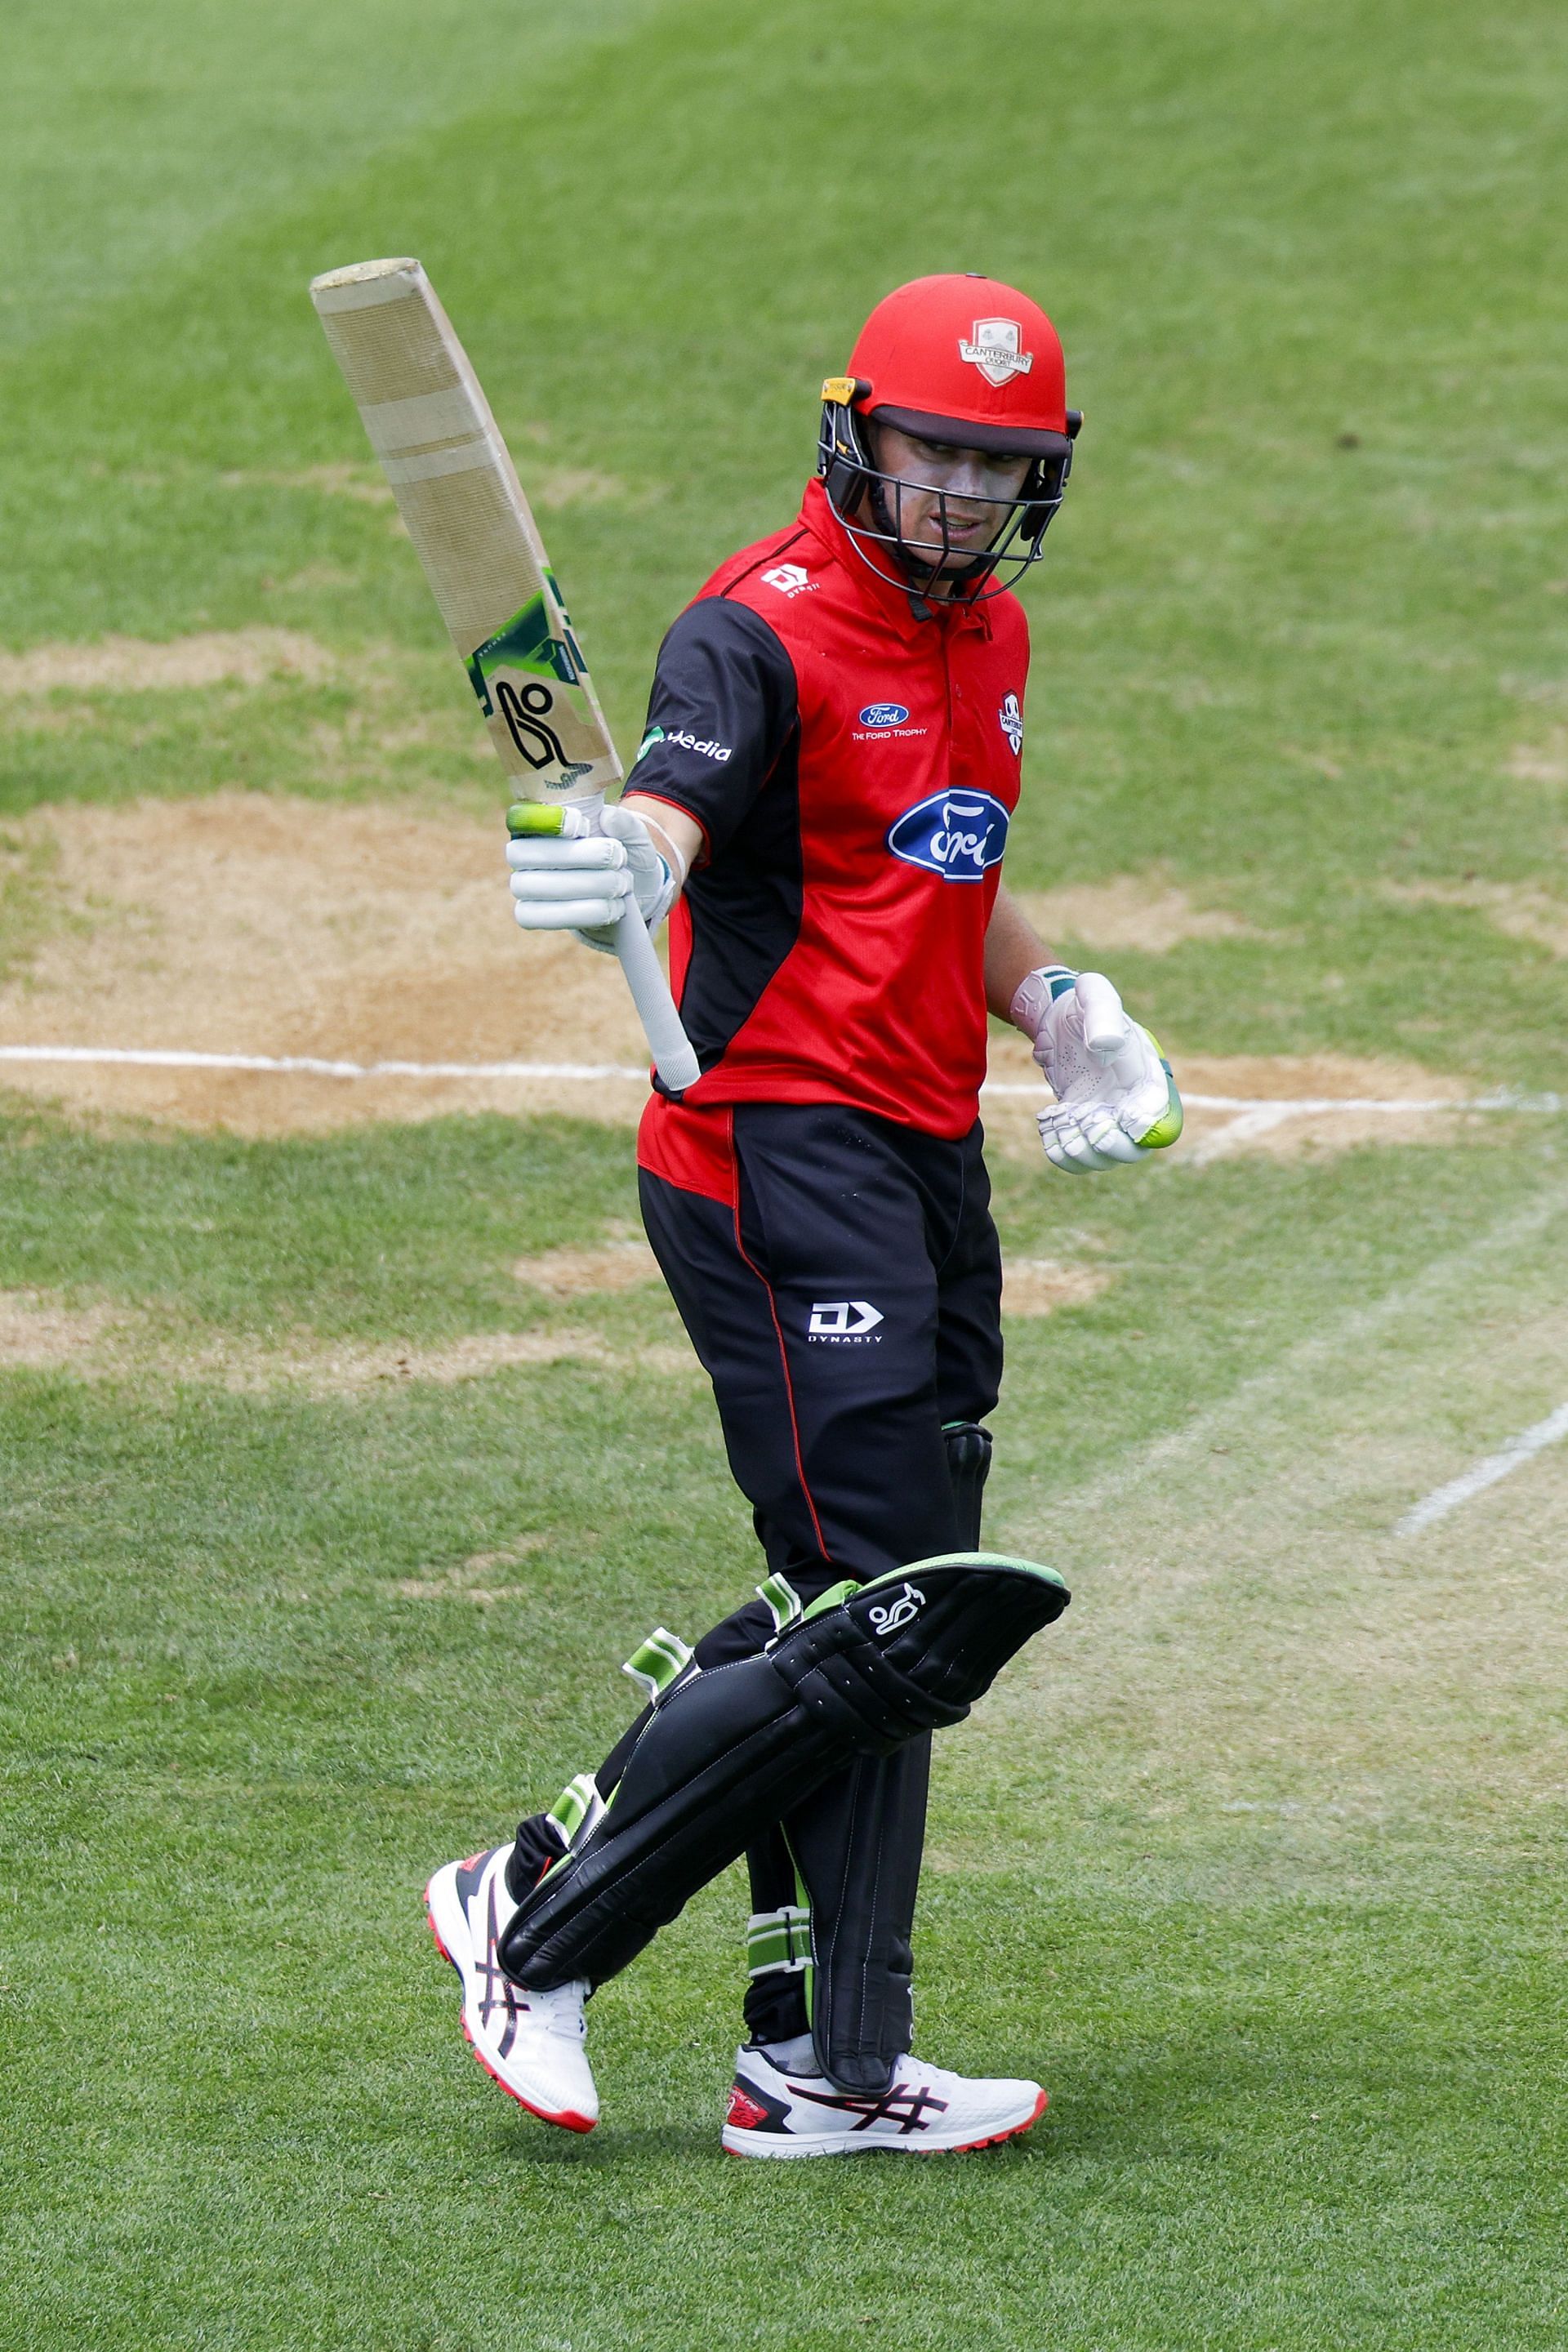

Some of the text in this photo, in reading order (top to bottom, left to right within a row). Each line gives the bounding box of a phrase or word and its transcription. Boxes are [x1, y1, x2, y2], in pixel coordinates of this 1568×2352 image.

[965, 347, 1030, 367] CANTERBURY
[867, 706, 899, 724] Ford
[852, 728, 928, 741] THE FORD TROPHY
[808, 1335, 883, 1343] DYNASTY
